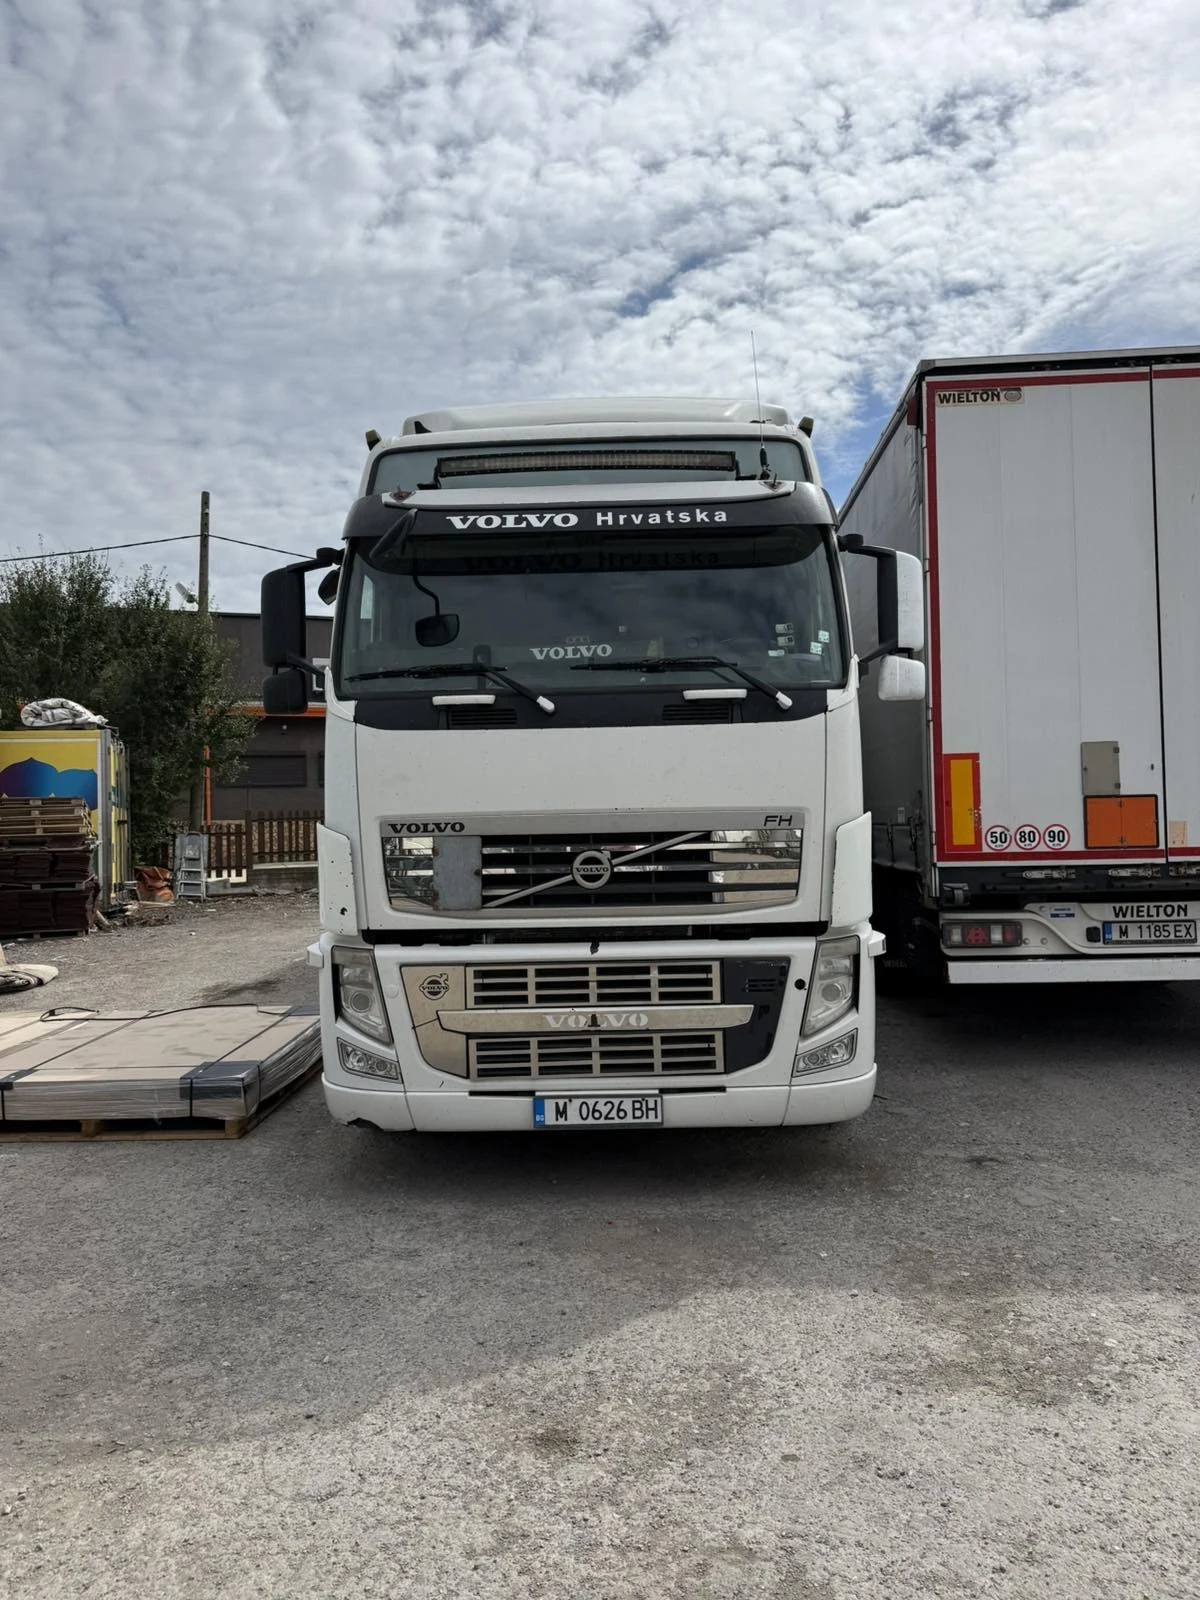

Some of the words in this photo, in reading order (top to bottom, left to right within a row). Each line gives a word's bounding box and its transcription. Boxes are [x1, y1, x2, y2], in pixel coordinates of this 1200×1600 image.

[938, 391, 1000, 404] WIELTON
[446, 513, 579, 530] VOLVO
[596, 508, 727, 526] Hrvatska
[529, 643, 613, 660] VOLVO
[763, 815, 793, 827] FH
[388, 822, 465, 834] VOLVO
[990, 831, 1008, 844] 50
[1018, 830, 1036, 843] 80
[1047, 830, 1065, 843] 90
[1112, 904, 1188, 918] WIELTON
[1119, 925, 1128, 938] M
[1137, 924, 1171, 938] 1185
[1174, 924, 1193, 938] EX
[555, 1101, 568, 1121] M
[579, 1100, 628, 1121] 0626
[631, 1099, 658, 1119] BH
